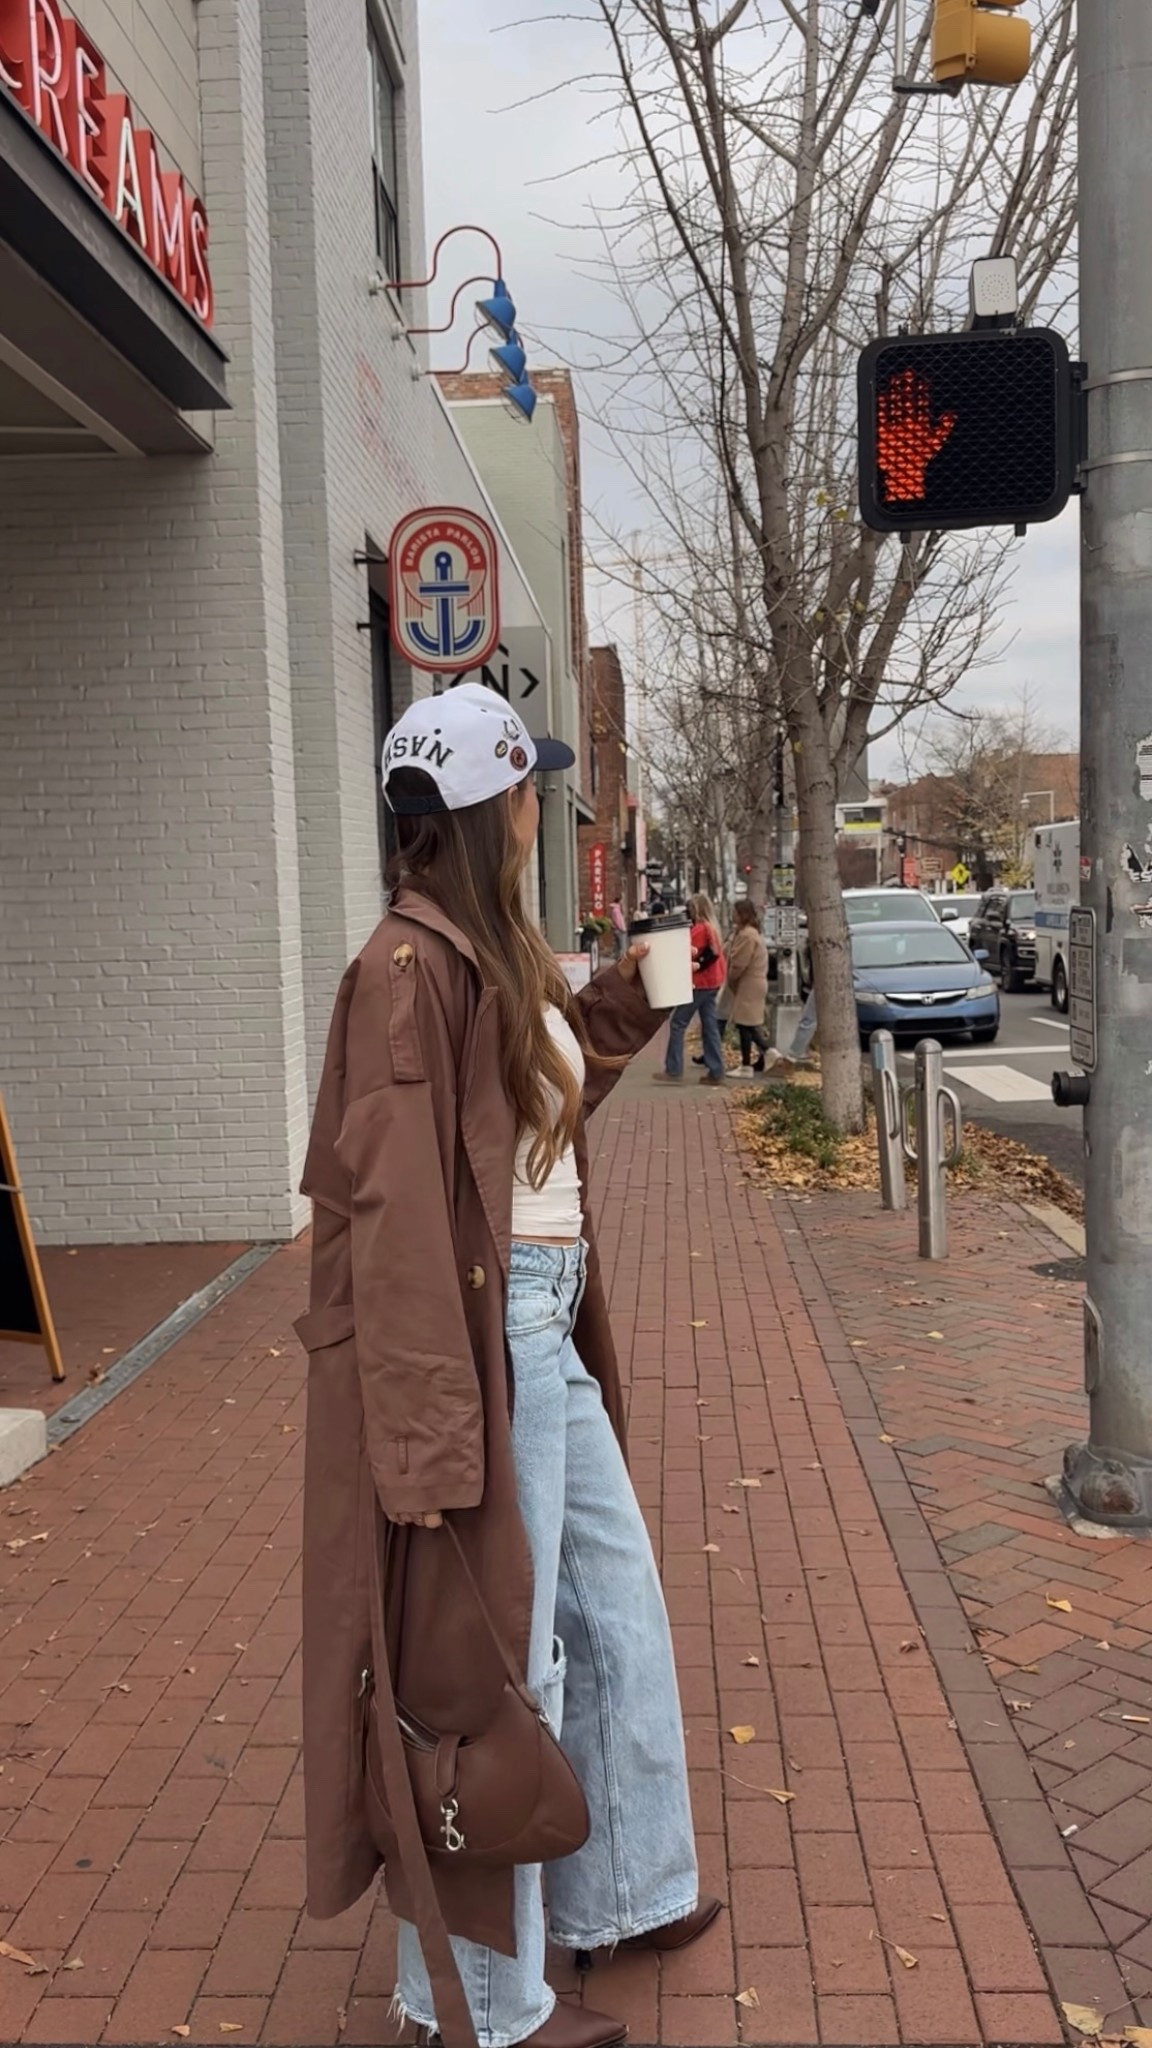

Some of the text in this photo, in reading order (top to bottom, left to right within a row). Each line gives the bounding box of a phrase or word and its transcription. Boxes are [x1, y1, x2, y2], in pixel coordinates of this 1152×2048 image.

[404, 527, 481, 567] BARISTA PARLOR
[593, 848, 604, 910] PARKING
